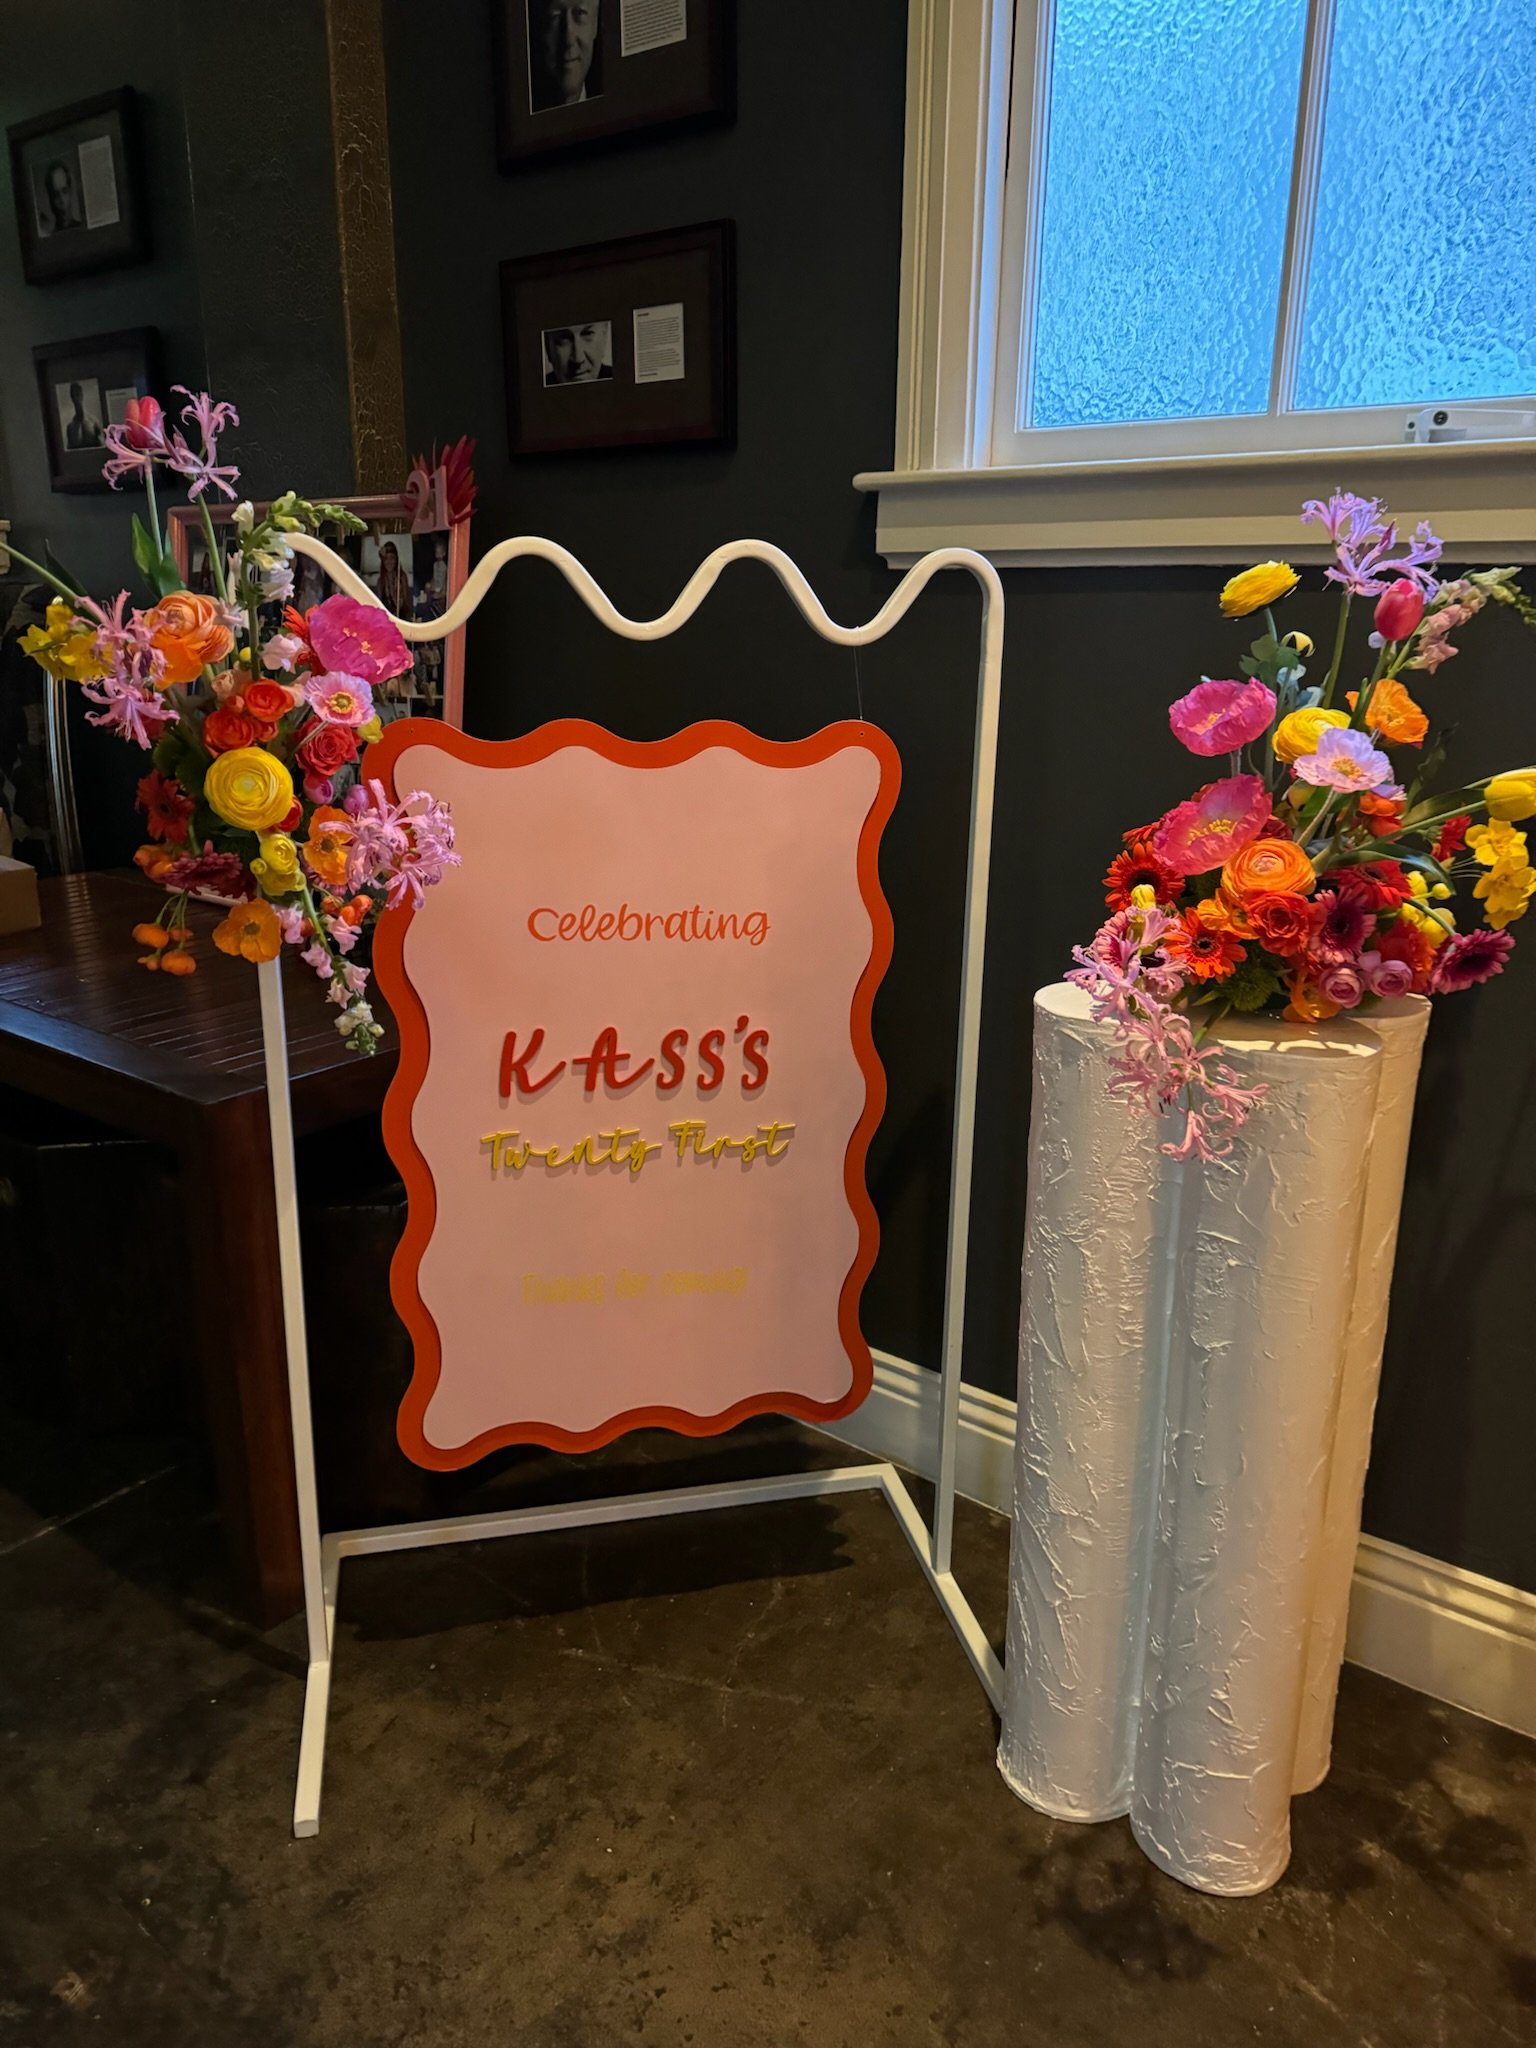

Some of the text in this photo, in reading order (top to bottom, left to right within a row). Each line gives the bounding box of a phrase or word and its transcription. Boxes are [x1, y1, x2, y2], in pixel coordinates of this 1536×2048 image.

[406, 466, 453, 533] 21
[527, 903, 771, 946] Celebrating
[480, 1119, 795, 1174] Twenty First
